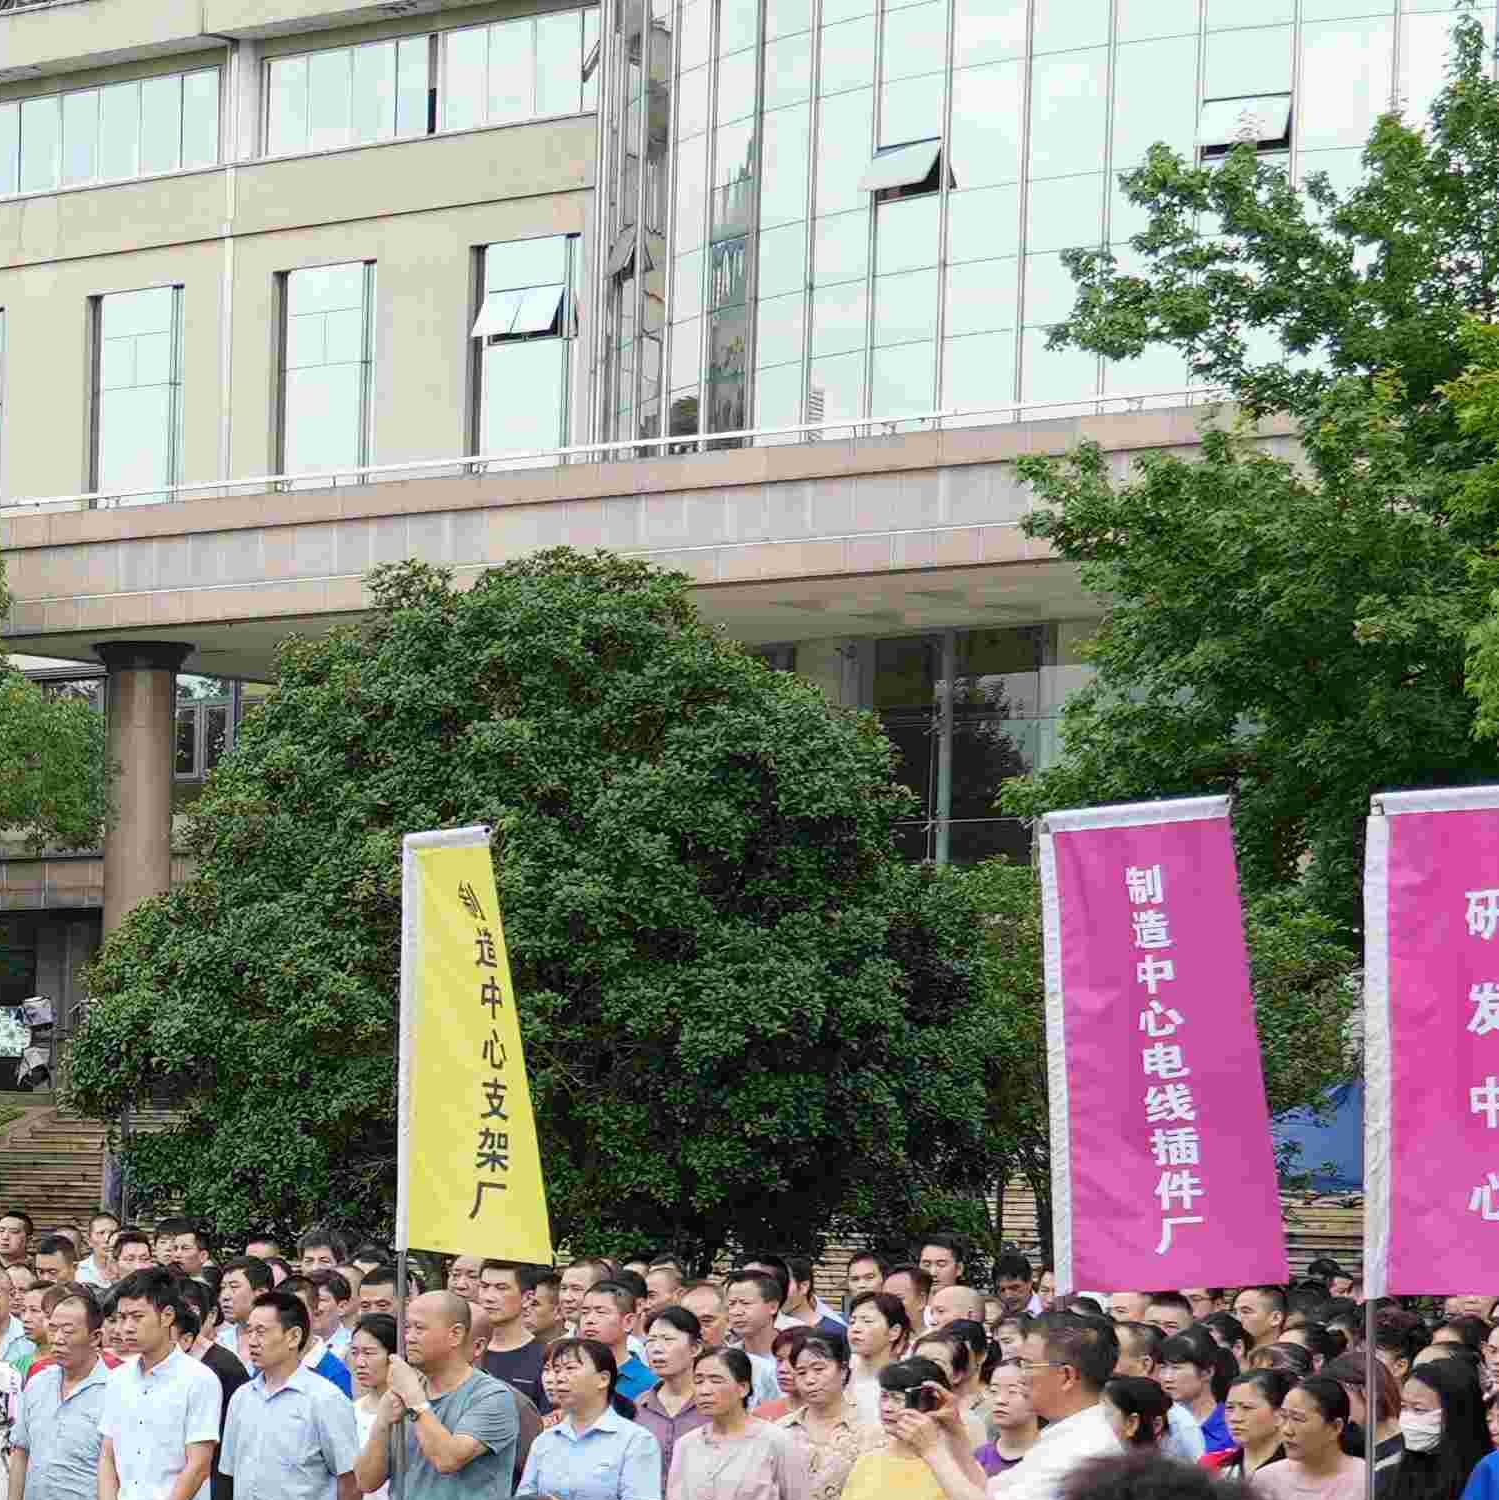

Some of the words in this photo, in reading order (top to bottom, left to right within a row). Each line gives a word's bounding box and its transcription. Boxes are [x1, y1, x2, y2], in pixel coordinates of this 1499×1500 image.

[457, 880, 509, 1219] 制造中心支架厂
[1125, 865, 1206, 1256] 制造中心电线插件厂
